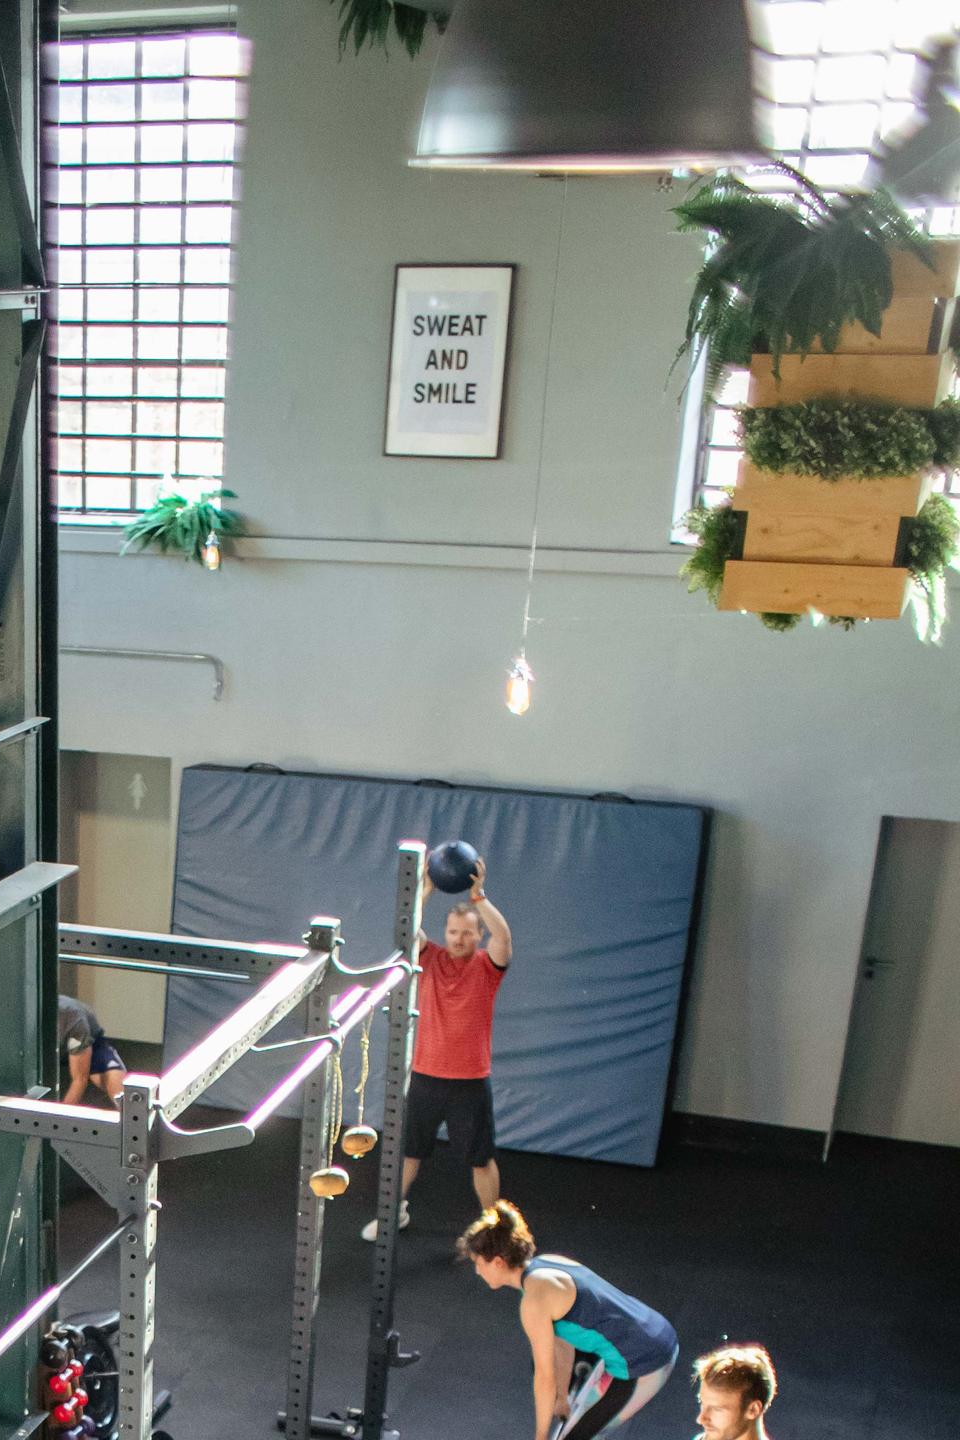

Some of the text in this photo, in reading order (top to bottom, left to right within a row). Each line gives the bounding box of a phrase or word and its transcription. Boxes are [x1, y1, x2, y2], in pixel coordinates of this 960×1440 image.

[412, 314, 487, 337] SWEAT
[425, 349, 468, 371] AND
[413, 382, 477, 404] SMILE
